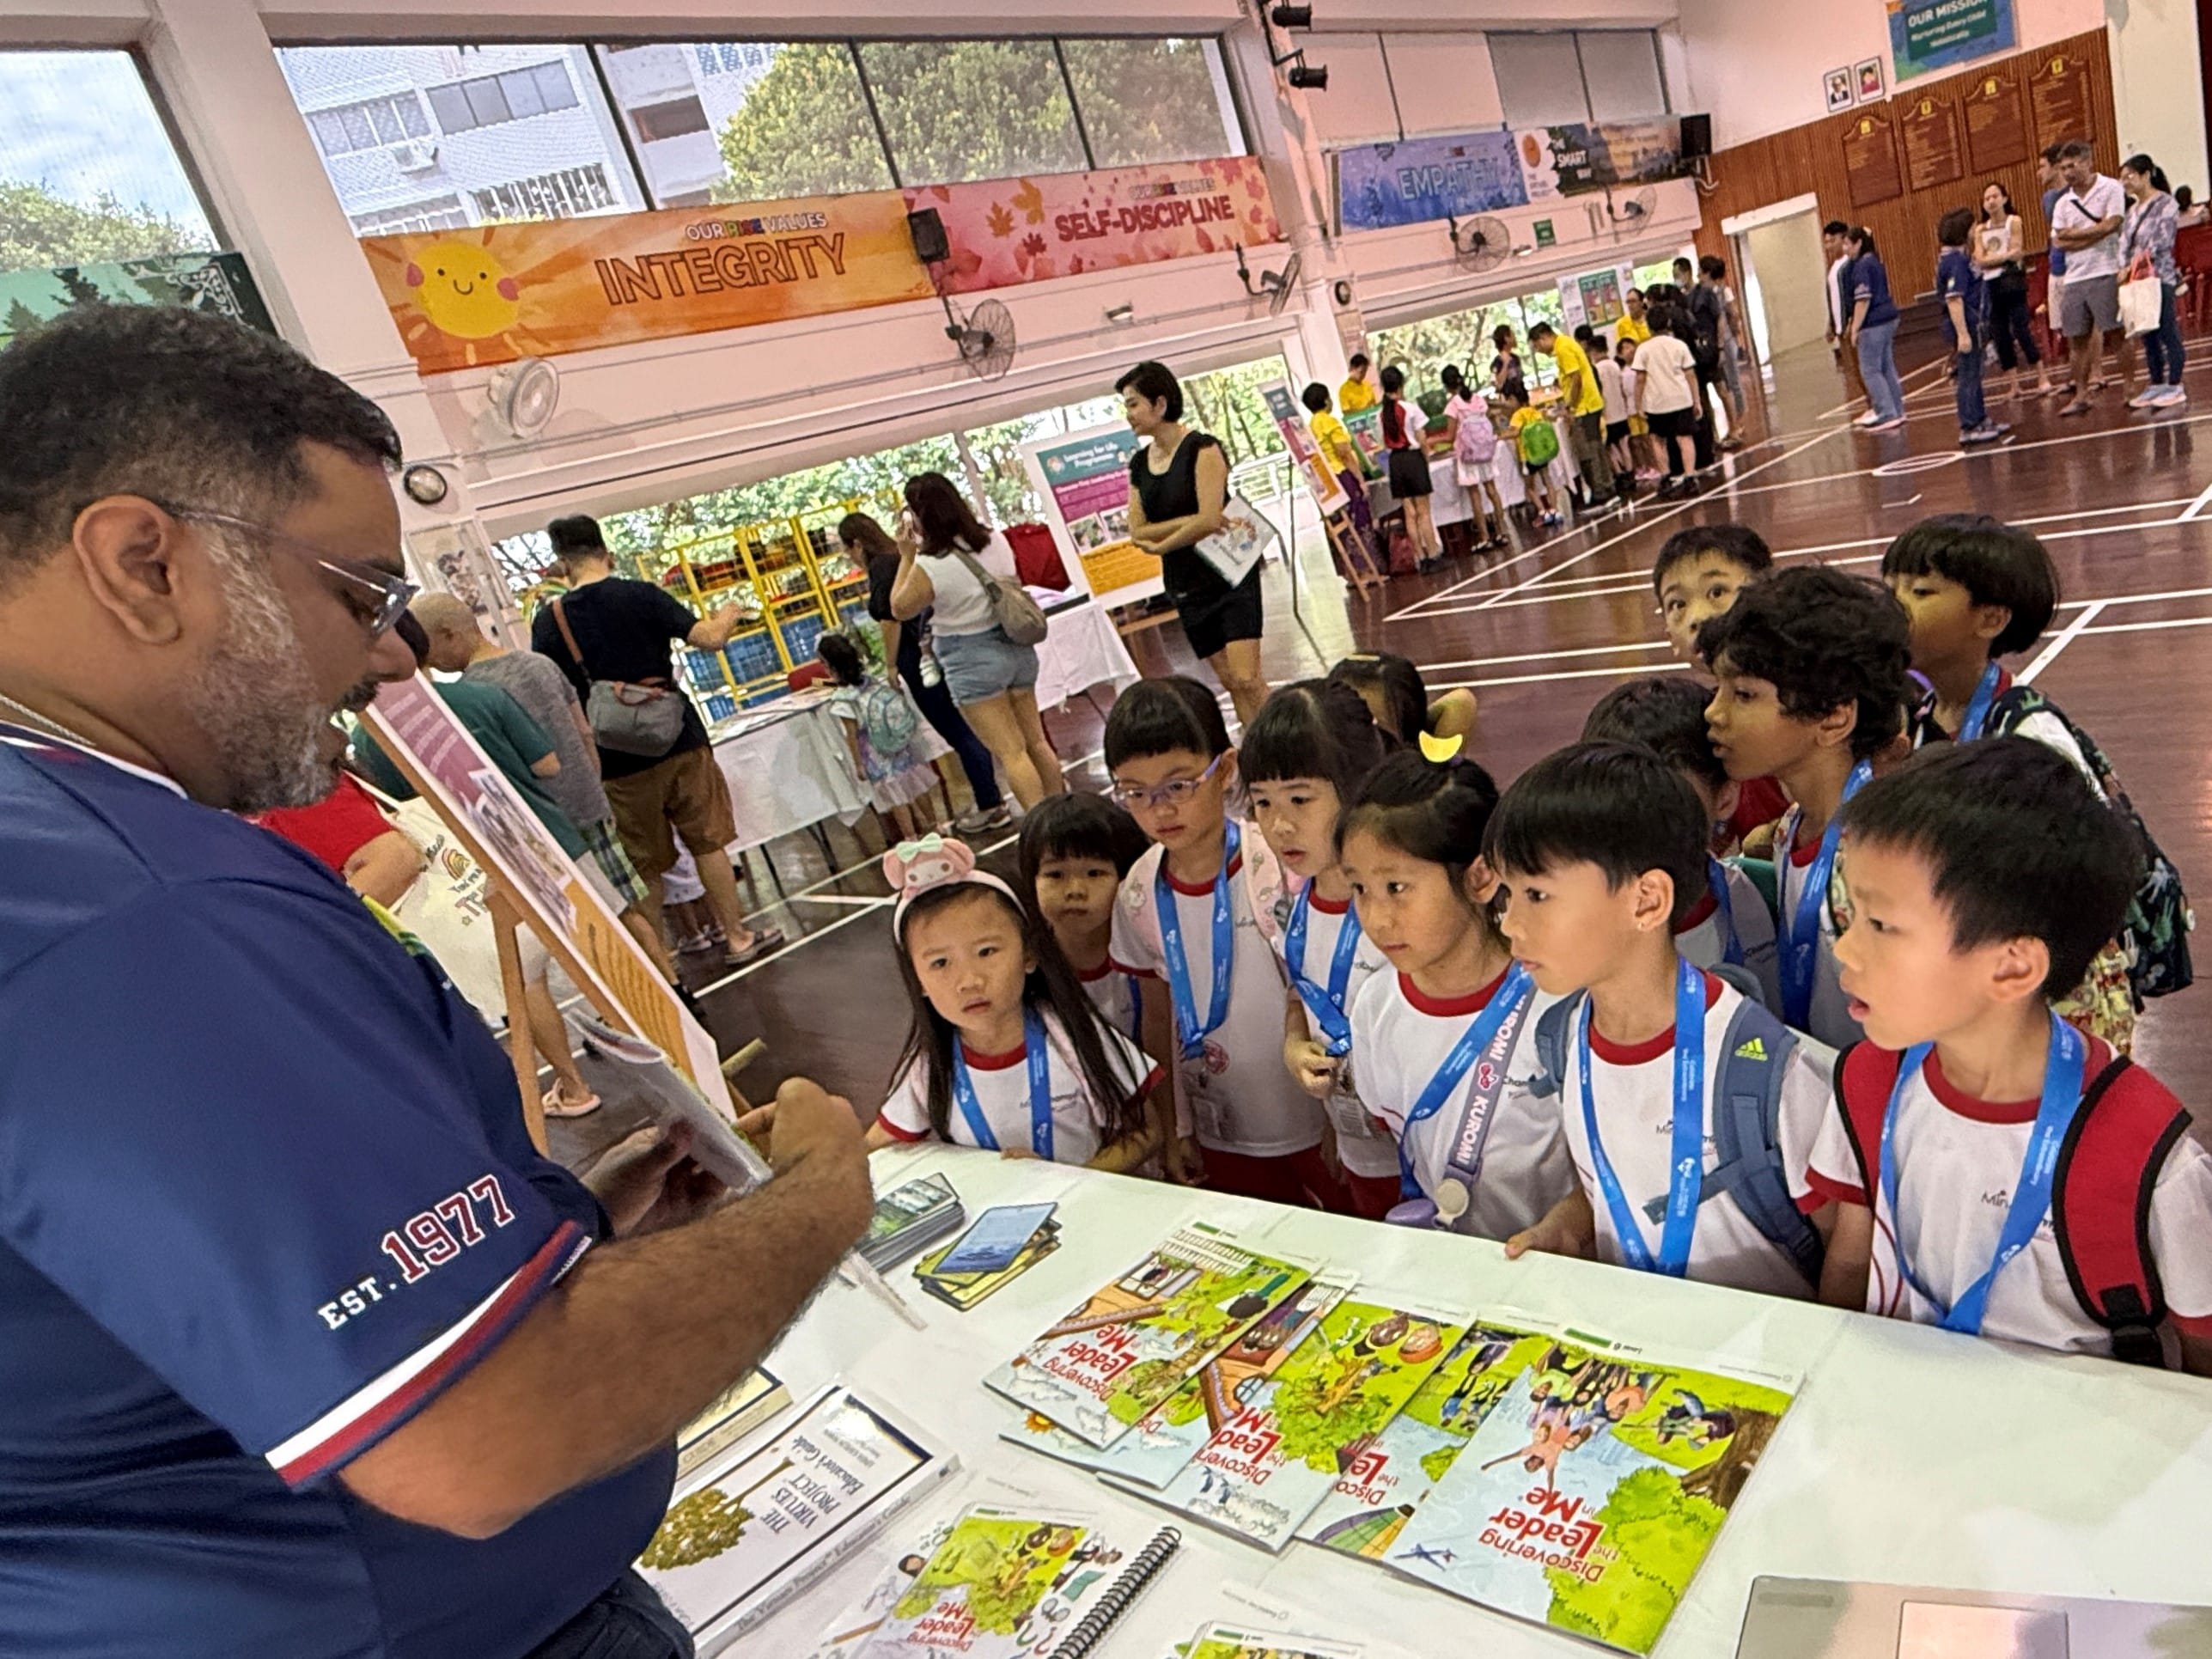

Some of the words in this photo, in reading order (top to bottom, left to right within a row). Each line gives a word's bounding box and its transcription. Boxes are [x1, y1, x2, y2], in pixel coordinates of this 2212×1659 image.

[1908, 9, 1935, 28] OUR
[1557, 149, 1587, 168] SMART
[686, 220, 725, 241] OUR
[763, 212, 827, 233] VALUES
[1055, 195, 1234, 243] SELF-DISCIPLINE
[595, 232, 846, 306] INTEGRITY
[1456, 1095, 1490, 1165] KUROMI
[317, 1276, 397, 1330] EST.
[381, 1174, 515, 1284] 1977
[1096, 1324, 1138, 1353] Me
[1042, 1356, 1118, 1402] Discovering
[1058, 1340, 1138, 1382] Leader
[1350, 1451, 1390, 1486] Le
[774, 1486, 818, 1529] VIRTUES
[789, 1473, 842, 1515] PROJECT
[1335, 1481, 1386, 1505] Disco
[1526, 1486, 1584, 1523] Me
[759, 1508, 791, 1534] THE
[1489, 1507, 1605, 1559] Leader
[1478, 1528, 1606, 1583] Discovering
[1593, 1546, 1618, 1561] the
[914, 1617, 977, 1640] Leader
[936, 1601, 969, 1620] Me
